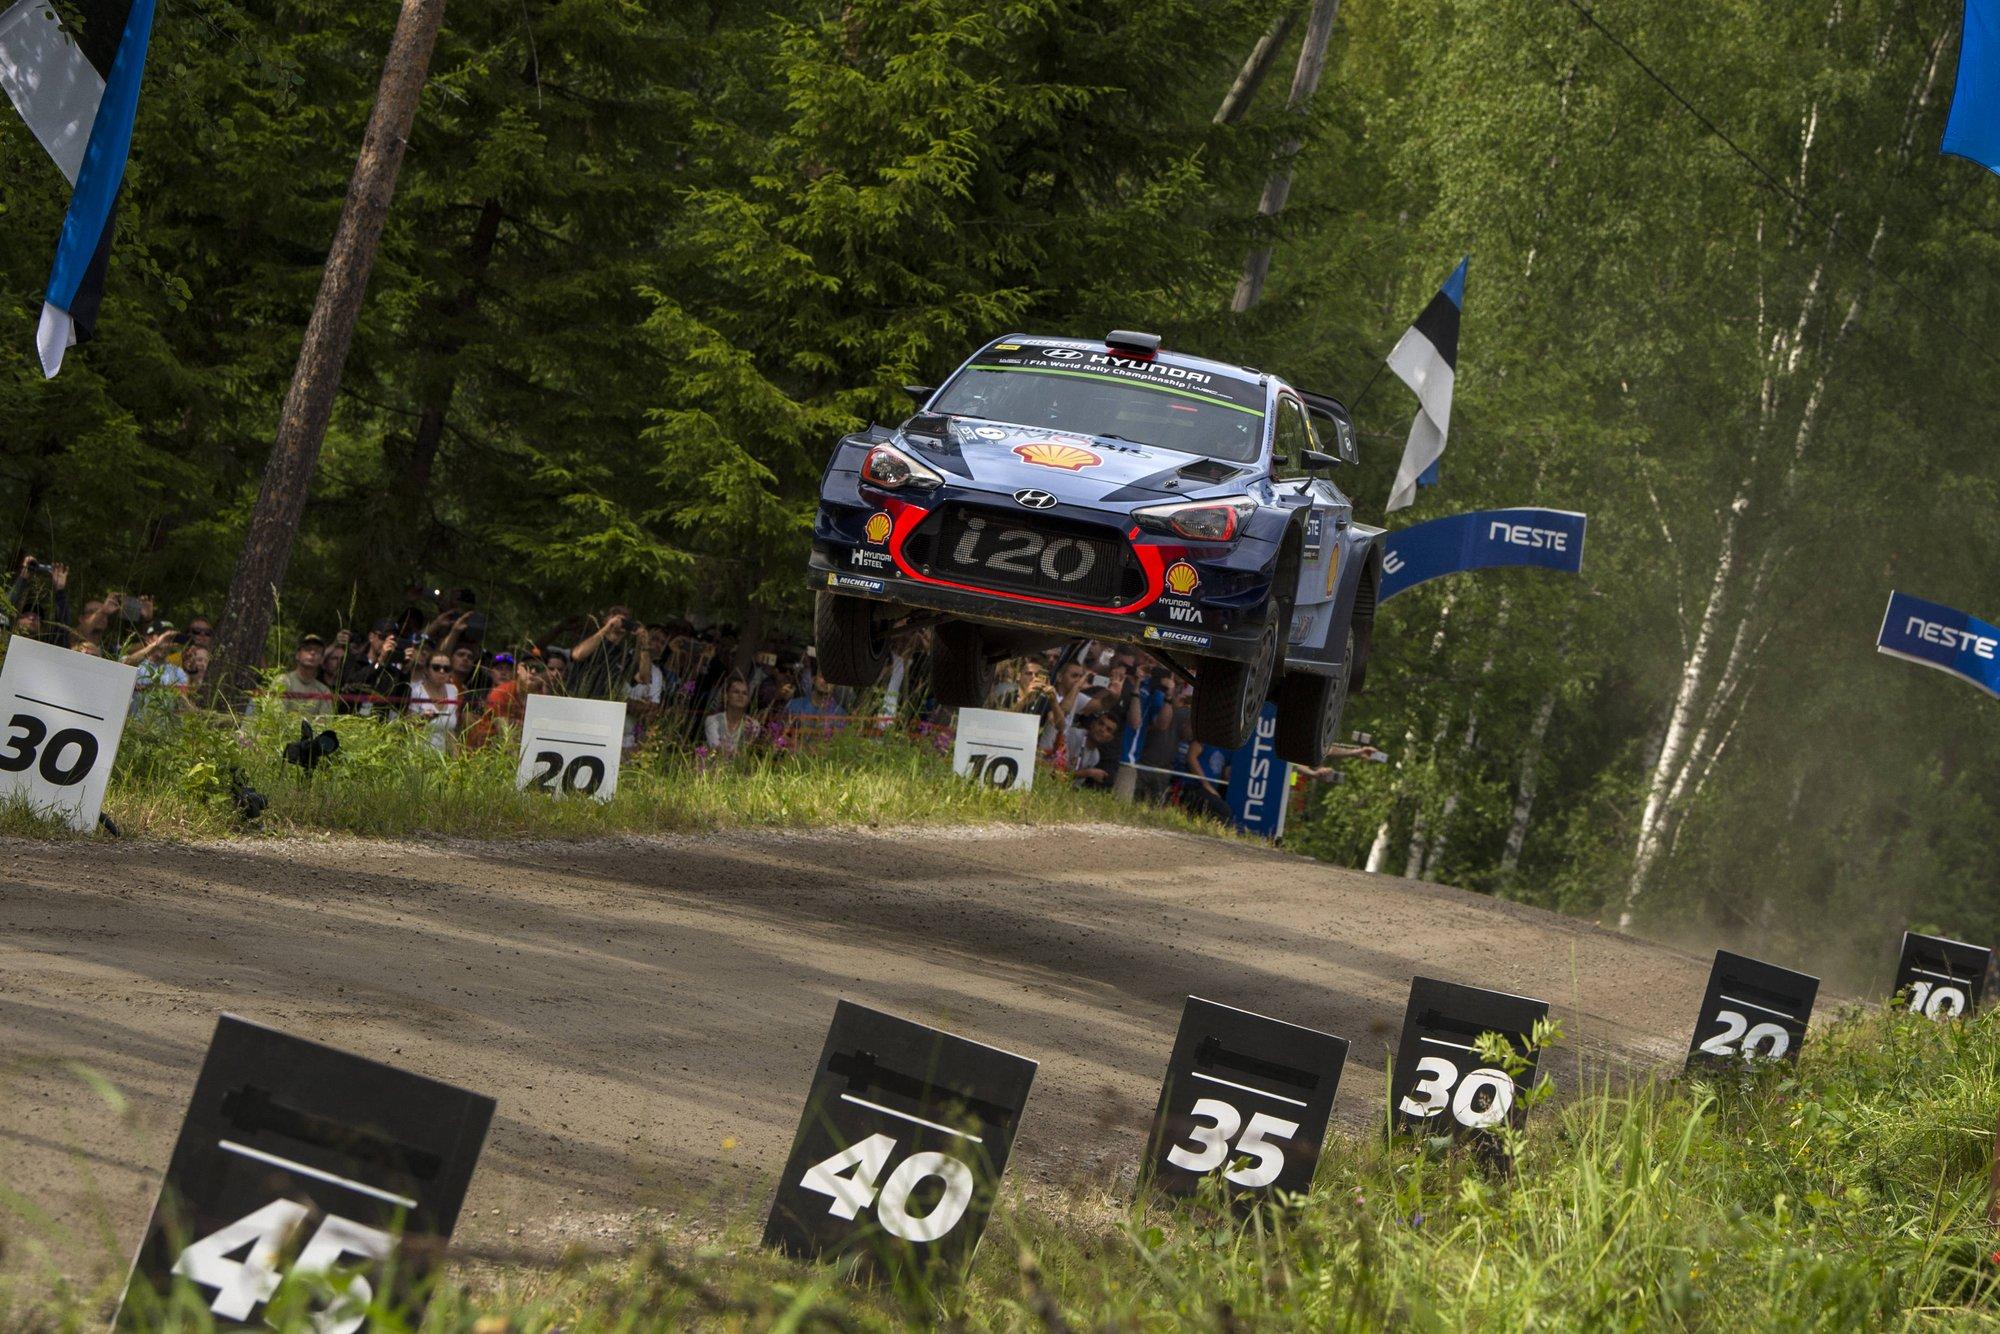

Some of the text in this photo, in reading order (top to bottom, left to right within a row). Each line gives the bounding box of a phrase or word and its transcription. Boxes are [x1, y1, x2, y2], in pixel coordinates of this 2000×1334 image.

[1050, 361, 1081, 369] World
[1083, 364, 1110, 374] Rally
[1112, 368, 1186, 388] Championship
[1090, 354, 1211, 383] HYUNDAI
[863, 551, 892, 562] HYUNDAI
[952, 517, 1096, 582] i20
[1489, 521, 1568, 551] NESTE
[840, 577, 881, 589] MICHELIN
[863, 559, 884, 568] STEEL
[1158, 598, 1191, 607] HYUNDAI
[1162, 631, 1208, 644] MICHELIN
[1905, 616, 1998, 660] NESTE
[0, 714, 99, 786] 30
[1243, 716, 1276, 821] NESTE
[522, 751, 605, 797] 20
[968, 754, 1019, 790] 10
[1909, 981, 1965, 1021] 10
[1700, 1010, 1790, 1061] 20
[1399, 1056, 1514, 1128] 30
[1167, 1098, 1300, 1188] 35
[800, 1133, 973, 1242] 40
[171, 1198, 401, 1334] 45
